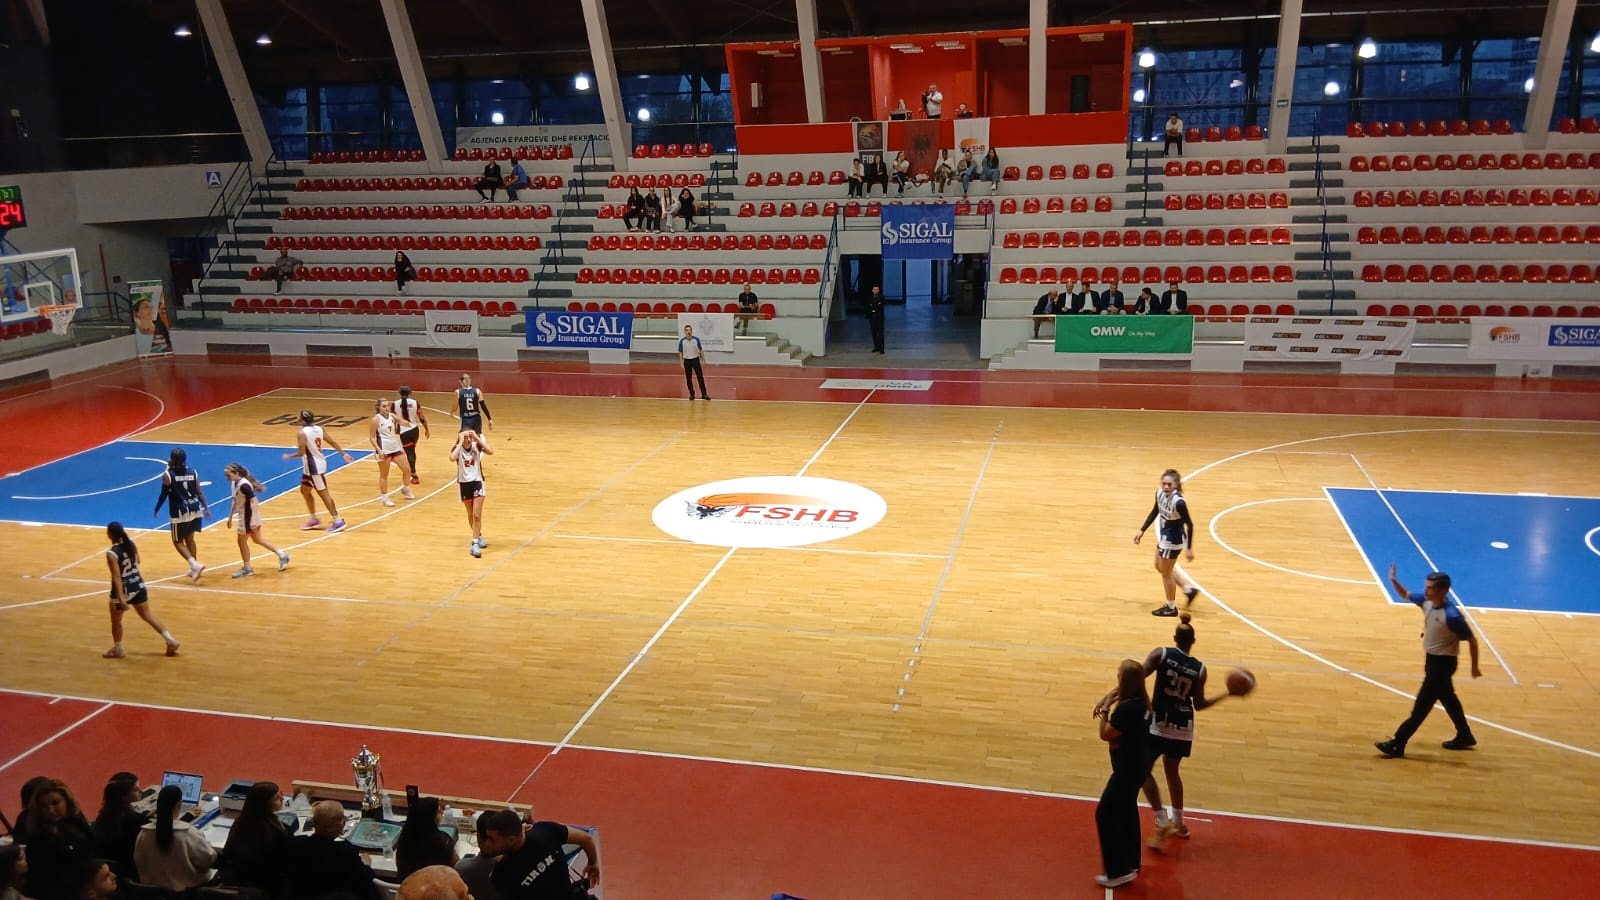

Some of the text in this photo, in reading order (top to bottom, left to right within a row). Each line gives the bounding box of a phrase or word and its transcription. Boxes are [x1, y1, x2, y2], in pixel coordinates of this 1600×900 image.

[470, 136, 507, 144] AGJENCIA
[508, 136, 513, 144] E
[514, 135, 549, 144] PARQEVE
[552, 135, 568, 143] DHE
[862, 155, 875, 164] FIB
[209, 171, 221, 186] A
[0, 204, 22, 225] 24
[899, 222, 953, 238] SIGAL
[557, 315, 625, 335] SIGAL
[1090, 326, 1127, 337] OMW
[537, 335, 546, 343] IG
[558, 334, 625, 345] Insurance Group
[466, 397, 474, 411] 6
[735, 505, 859, 522] FSHB
